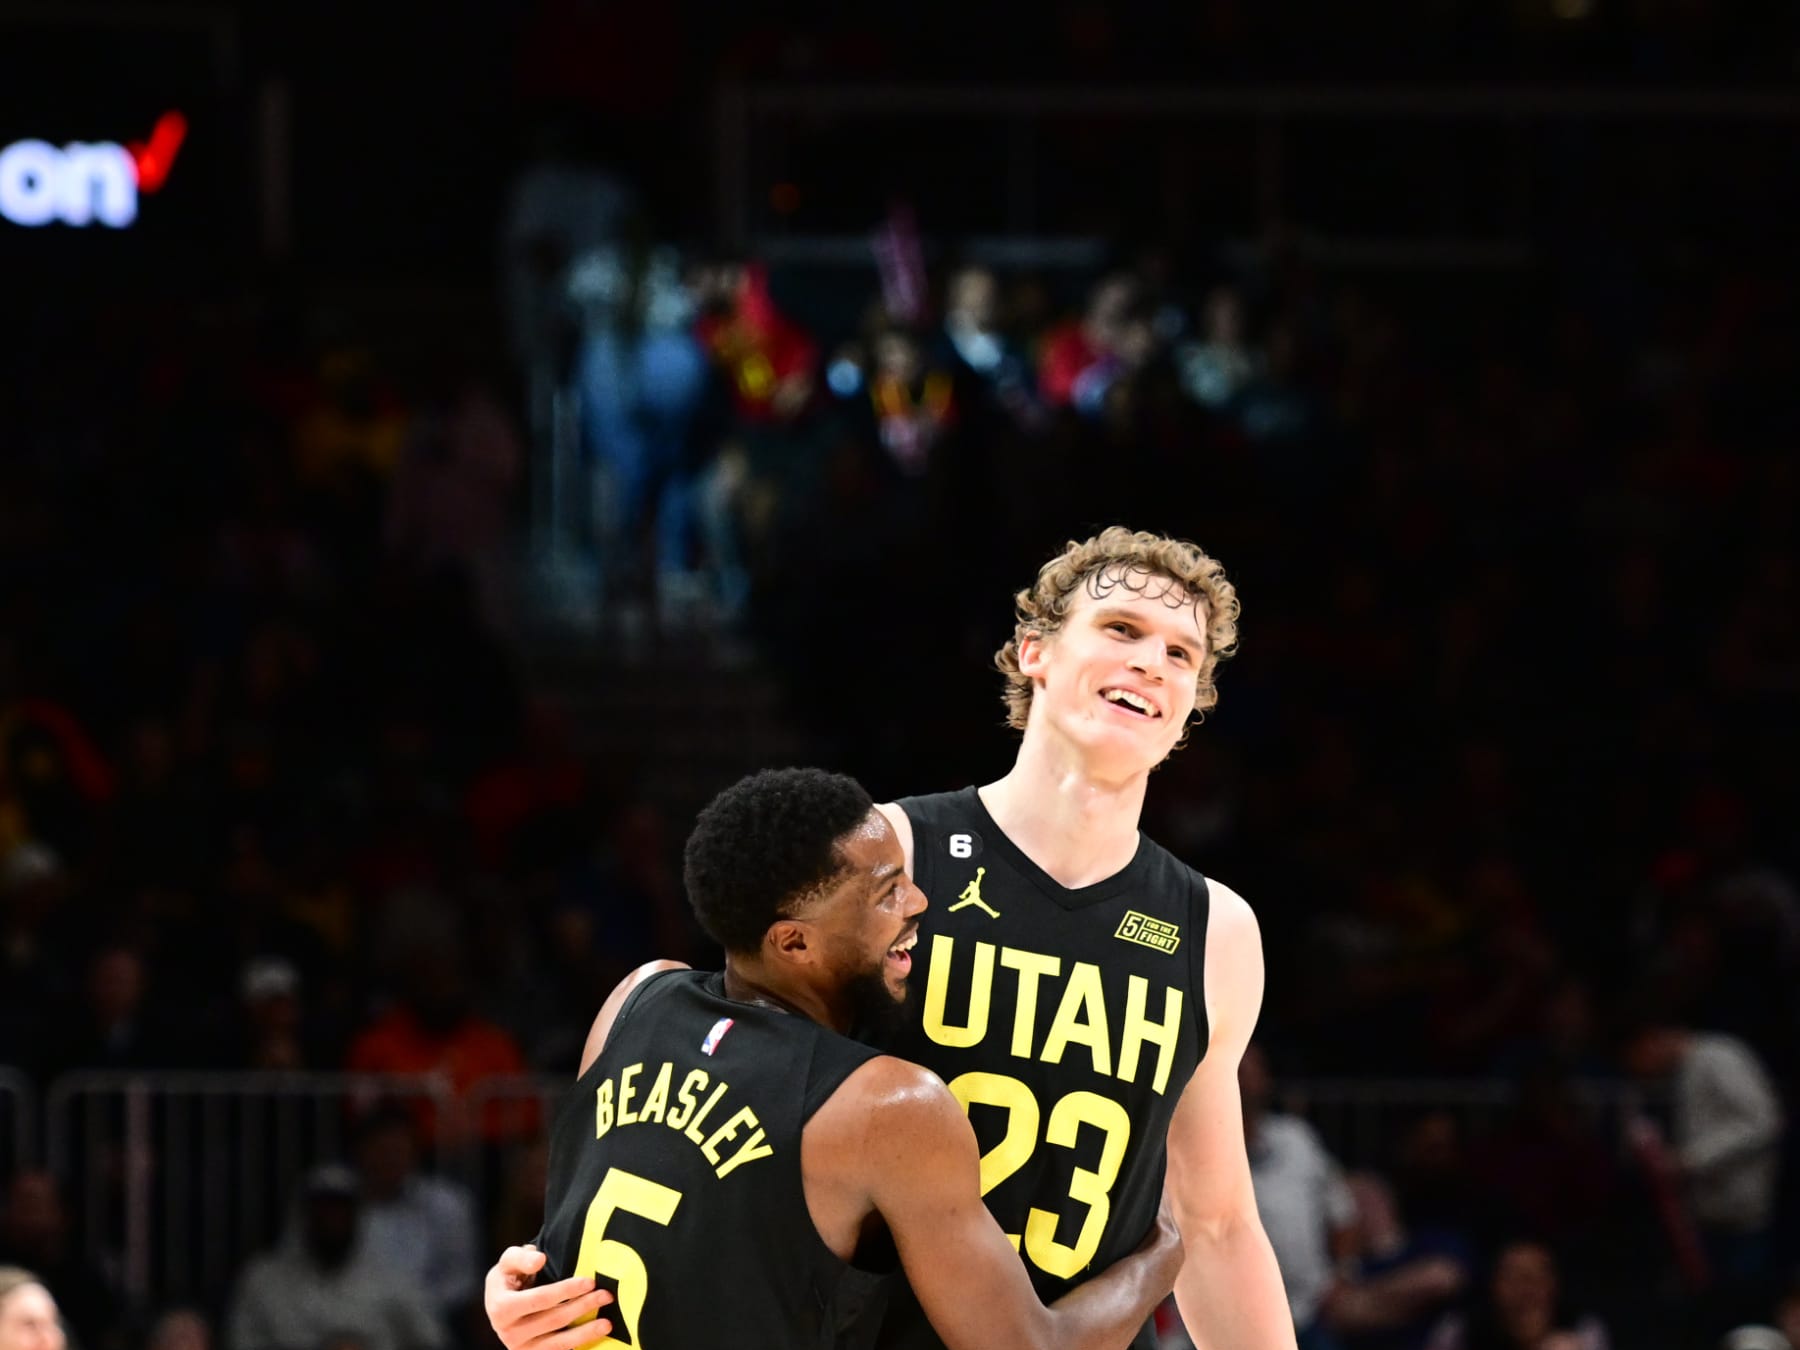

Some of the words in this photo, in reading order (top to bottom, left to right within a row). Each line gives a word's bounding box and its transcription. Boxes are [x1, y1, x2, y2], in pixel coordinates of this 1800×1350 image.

[950, 834, 972, 858] 6
[1122, 915, 1142, 937] 5
[1139, 931, 1174, 949] FIGHT
[922, 934, 1184, 1096] UTAH
[596, 1062, 774, 1180] BEASLEY
[946, 1071, 1131, 1280] 23
